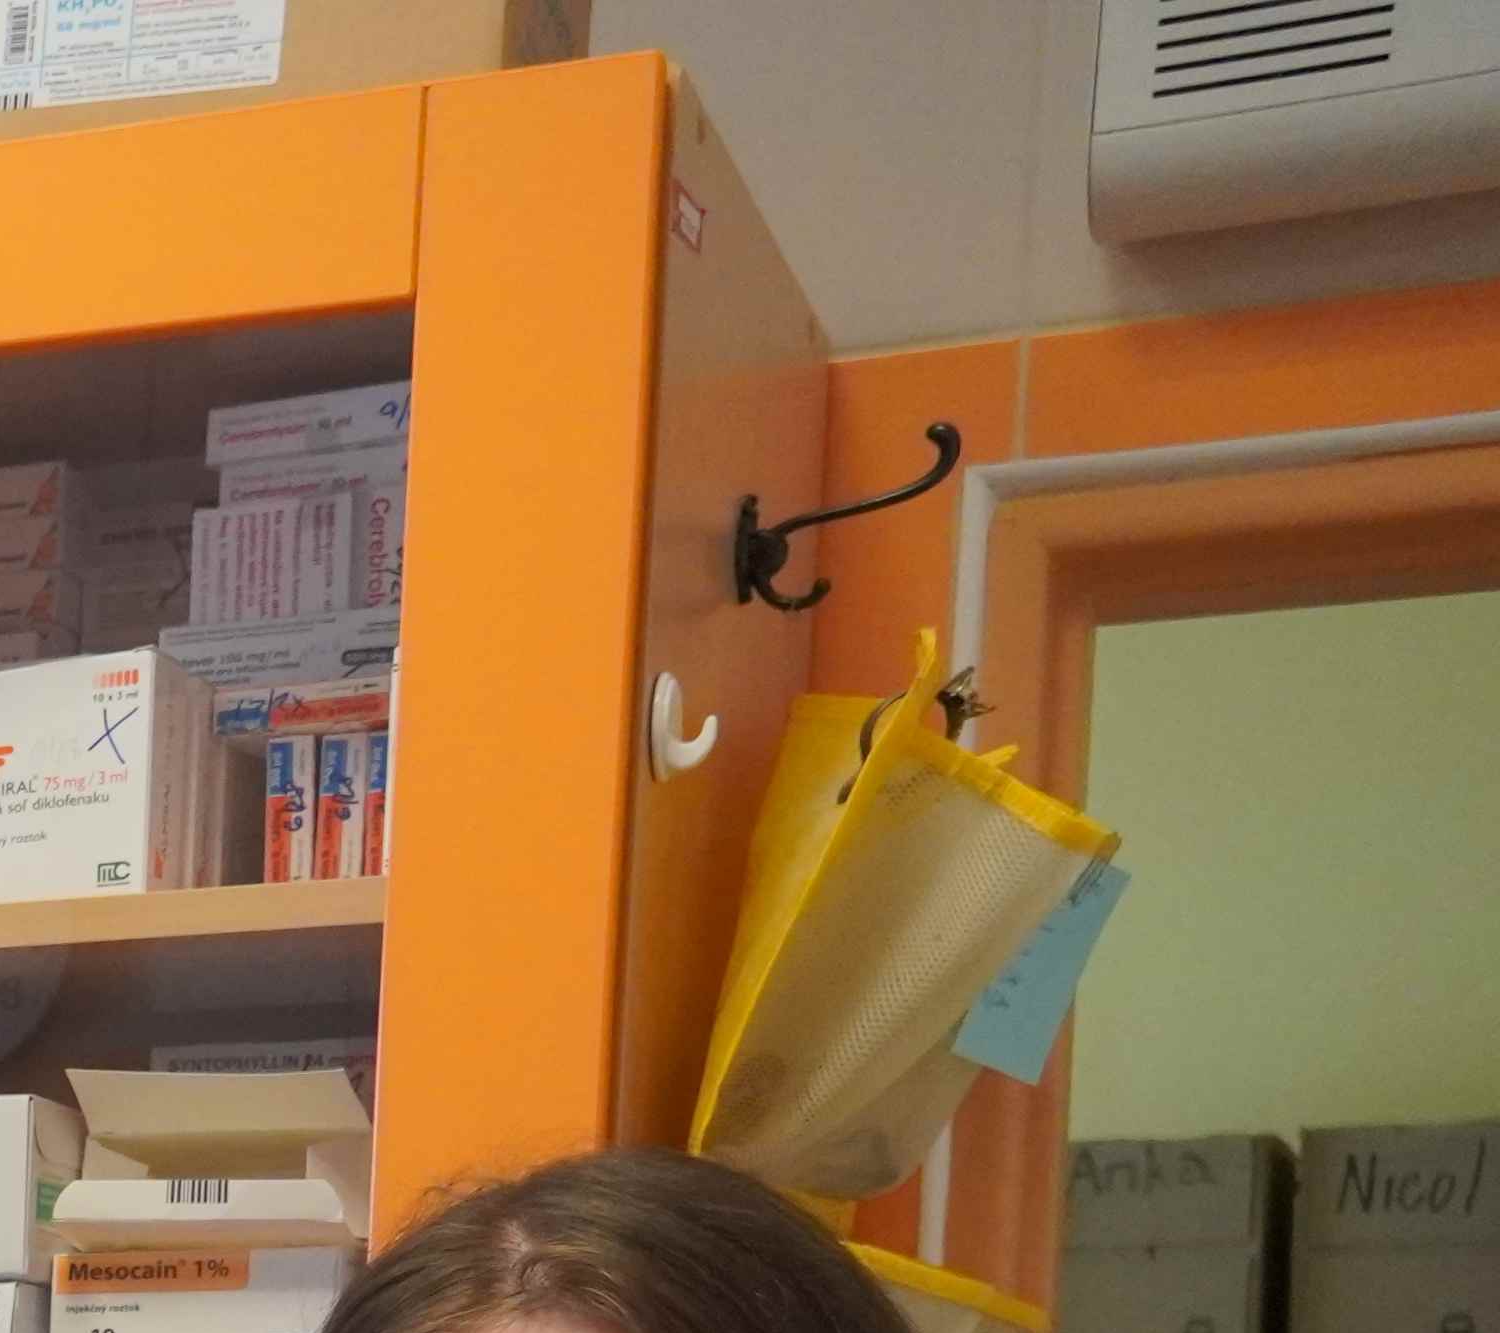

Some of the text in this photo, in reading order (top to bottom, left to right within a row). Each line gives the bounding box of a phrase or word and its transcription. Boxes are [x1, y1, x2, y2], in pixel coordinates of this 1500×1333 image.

[32, 790, 110, 811] diklofenaku
[1336, 1138, 1486, 1216] Nicol
[194, 1259, 229, 1278] 1%
